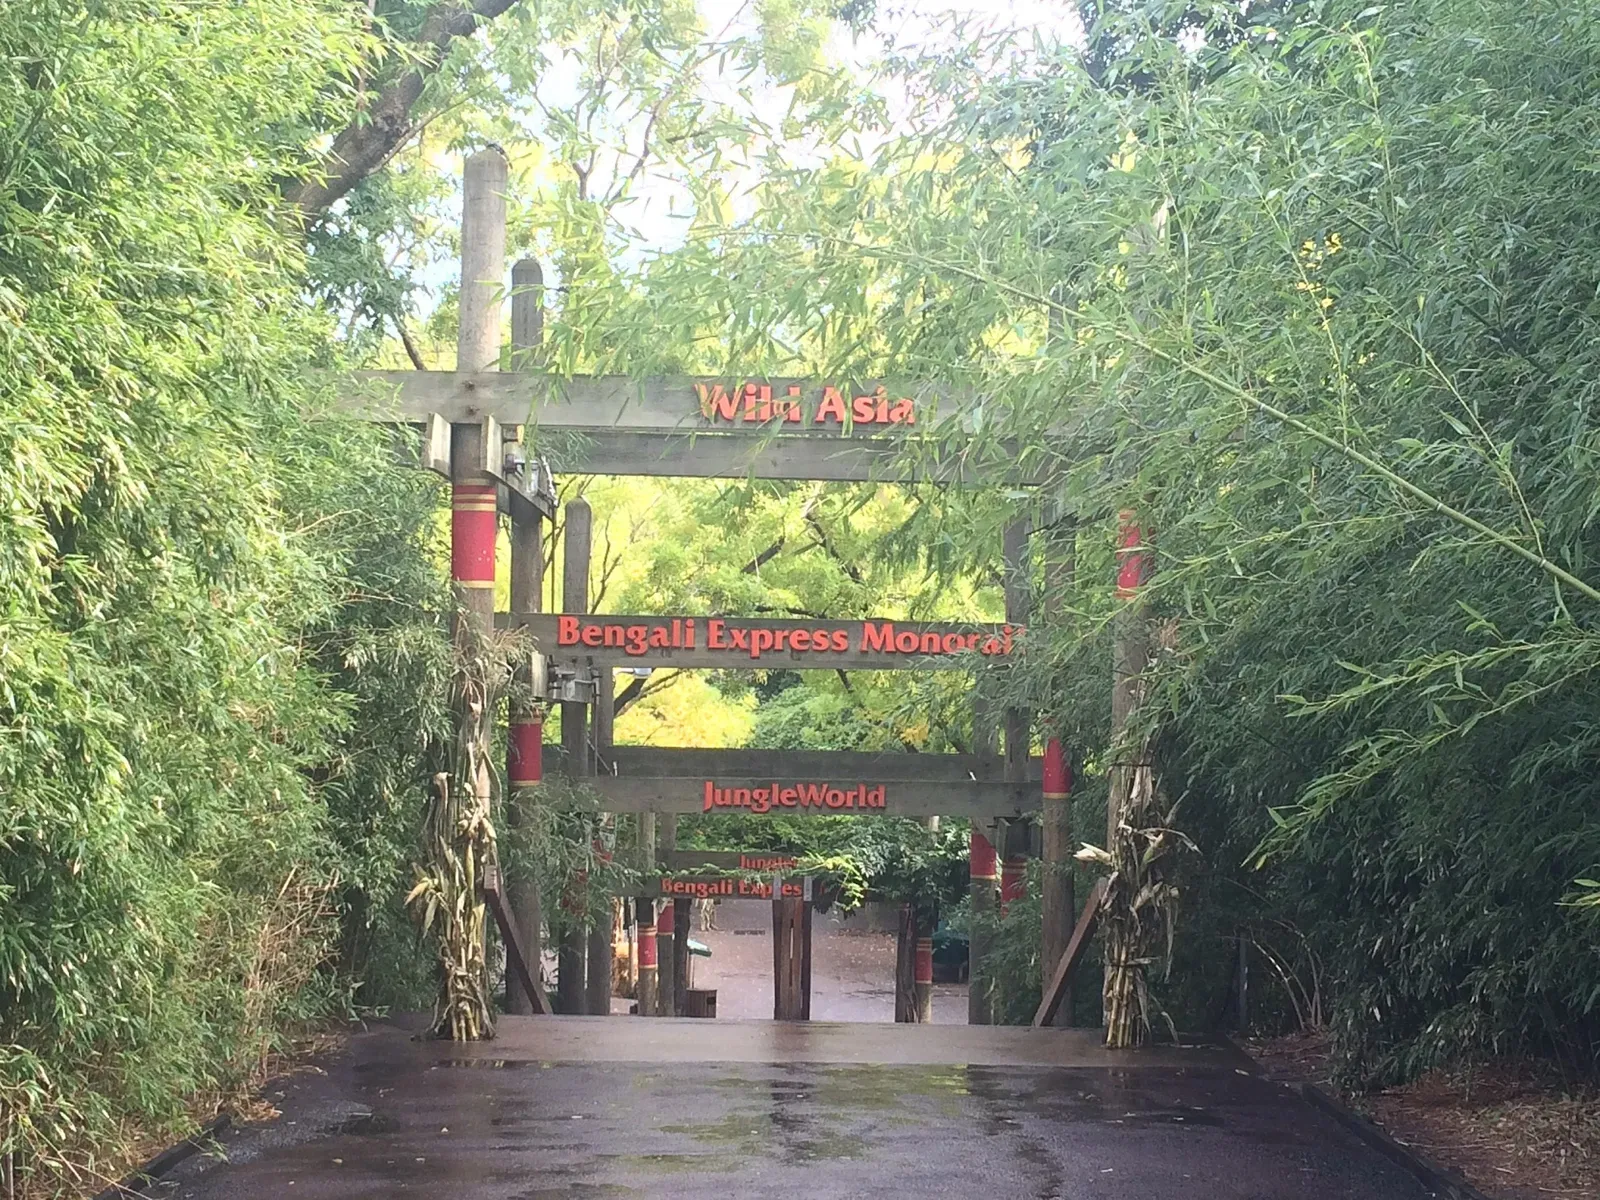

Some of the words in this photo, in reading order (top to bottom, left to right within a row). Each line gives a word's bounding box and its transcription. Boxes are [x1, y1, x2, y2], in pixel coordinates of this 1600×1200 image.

[695, 383, 801, 421] Wild
[815, 384, 915, 424] Asia
[558, 616, 696, 655] Bengali
[708, 619, 848, 658] Express
[703, 780, 887, 813] JungleWorld
[661, 877, 733, 898] Bengali
